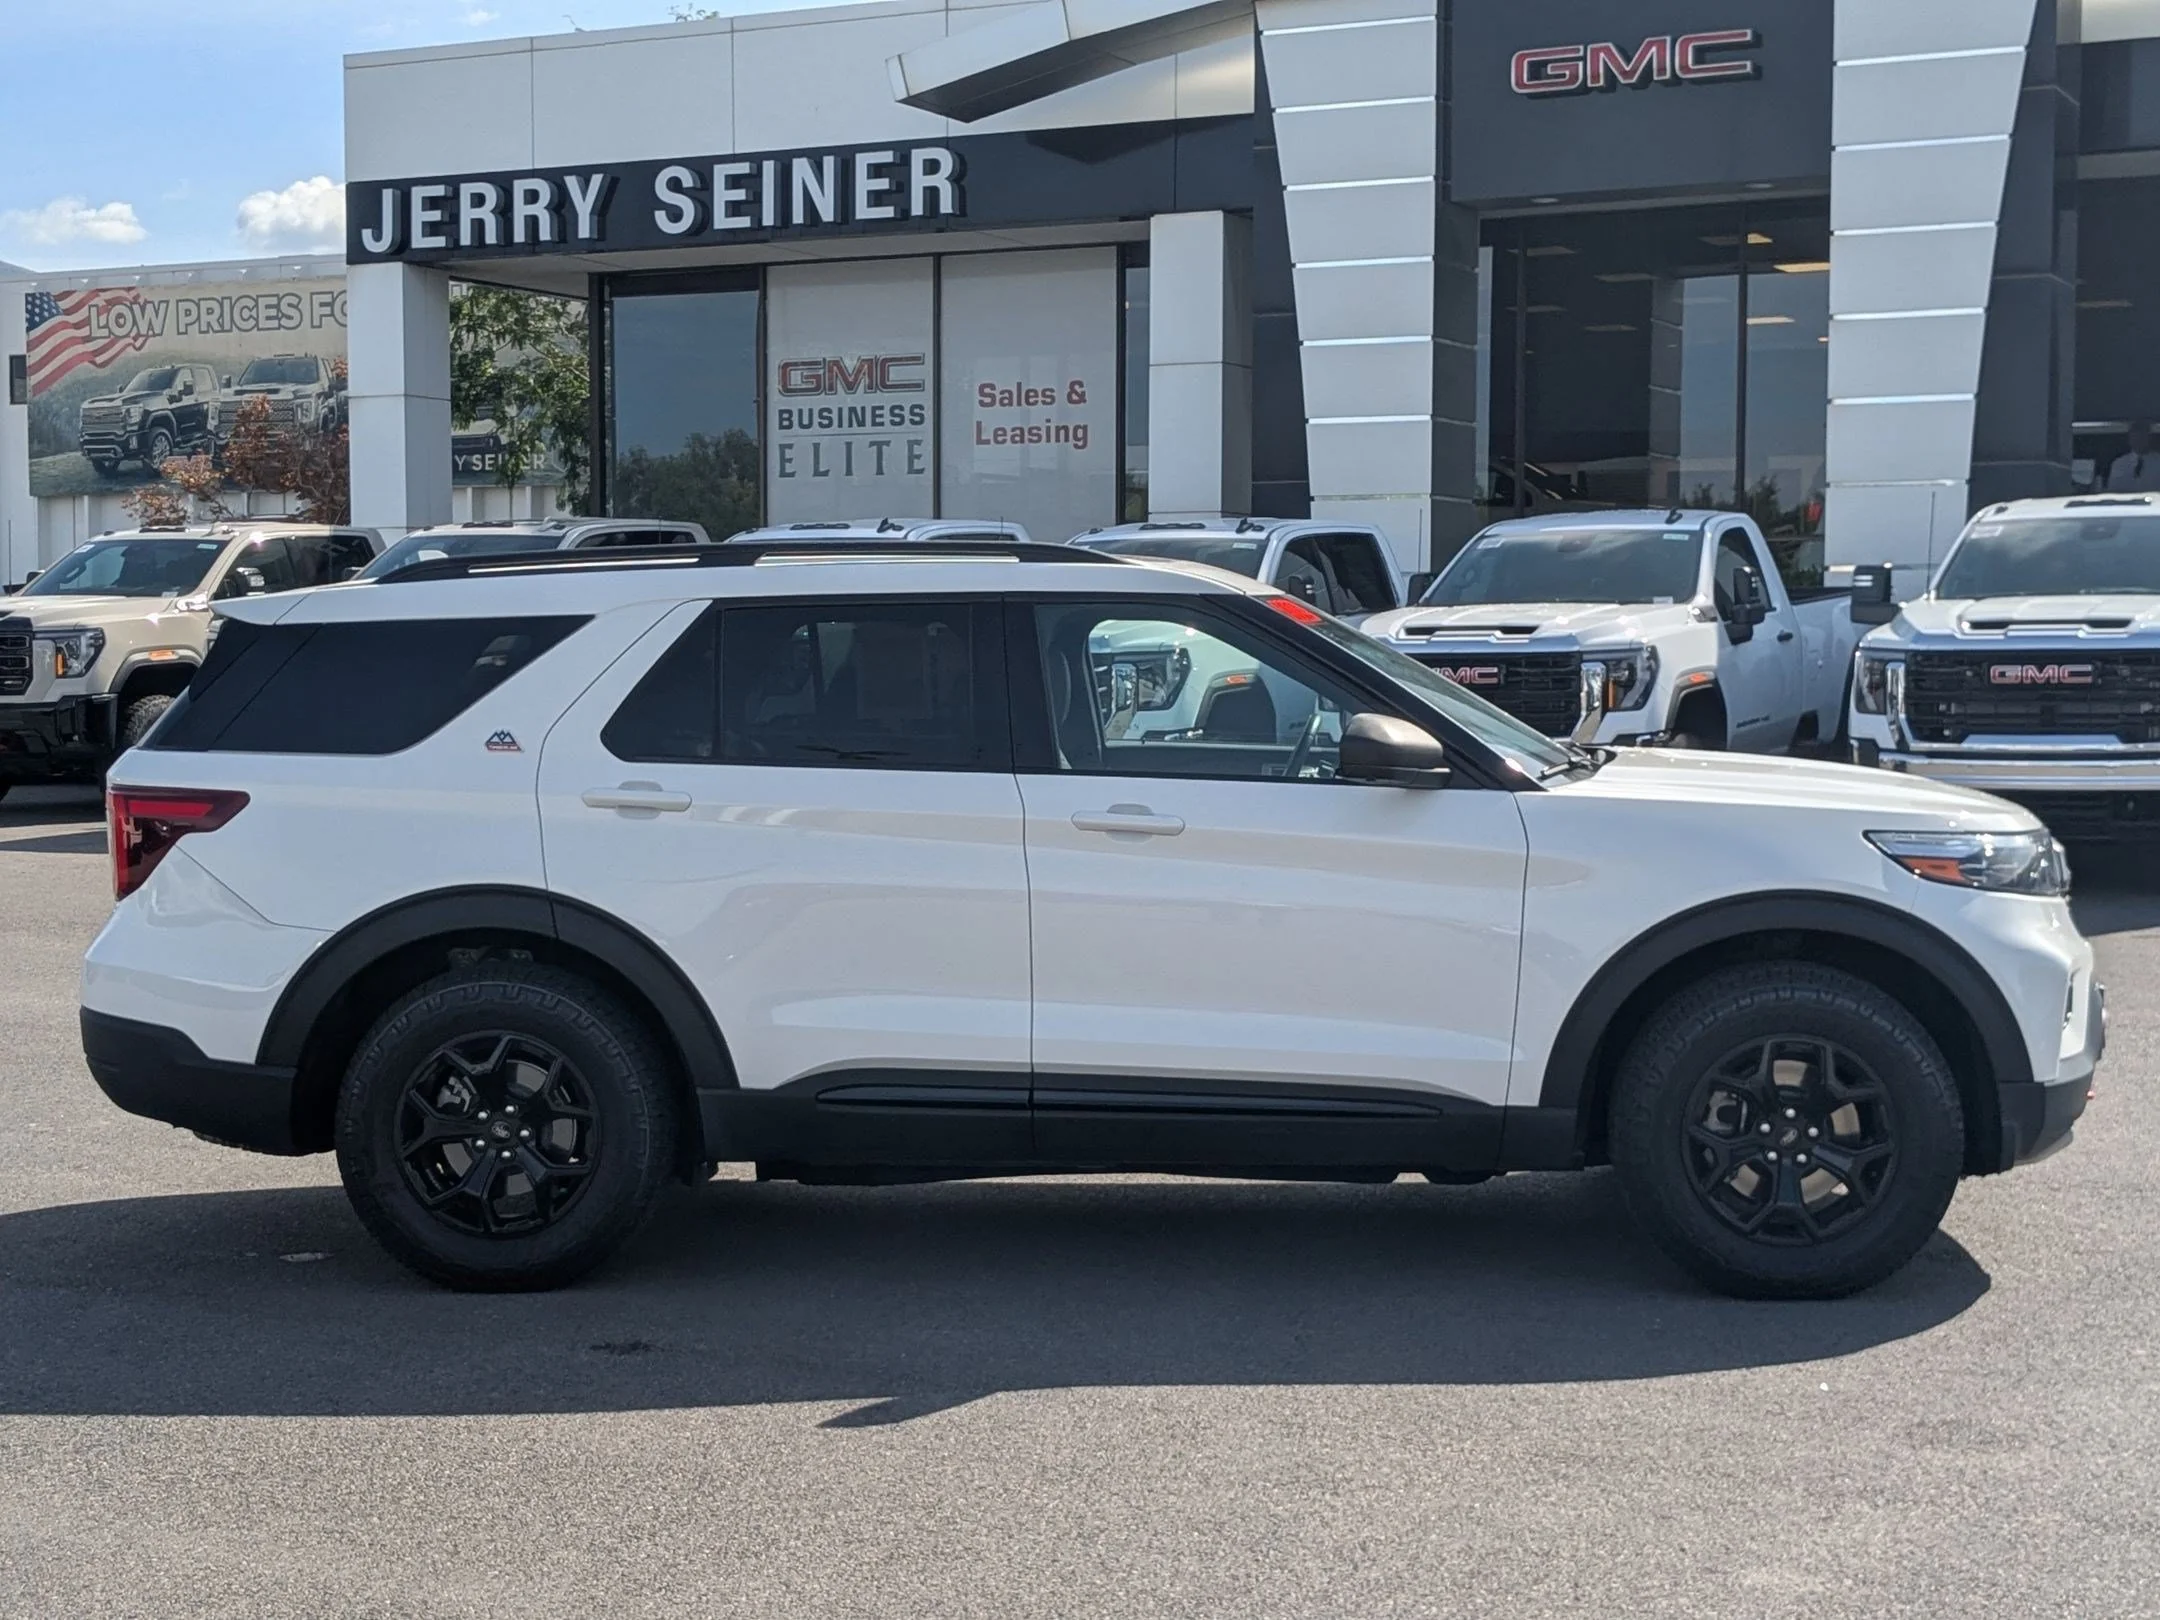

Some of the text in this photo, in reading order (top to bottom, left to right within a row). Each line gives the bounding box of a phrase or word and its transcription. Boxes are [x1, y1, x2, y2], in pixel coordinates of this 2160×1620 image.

[1510, 28, 1754, 94] GMC
[361, 146, 957, 254] JERRY SEINER
[89, 299, 170, 338] LOW
[176, 292, 303, 336] PRICES
[778, 352, 925, 397] GMC
[978, 379, 1087, 408] Sales &
[778, 403, 925, 430] BUSINESS
[975, 418, 1088, 450] Leasing
[471, 452, 545, 471] SEIER
[778, 439, 926, 478] ELITE
[1431, 666, 1498, 684] MC
[1990, 664, 2092, 684] GMC
